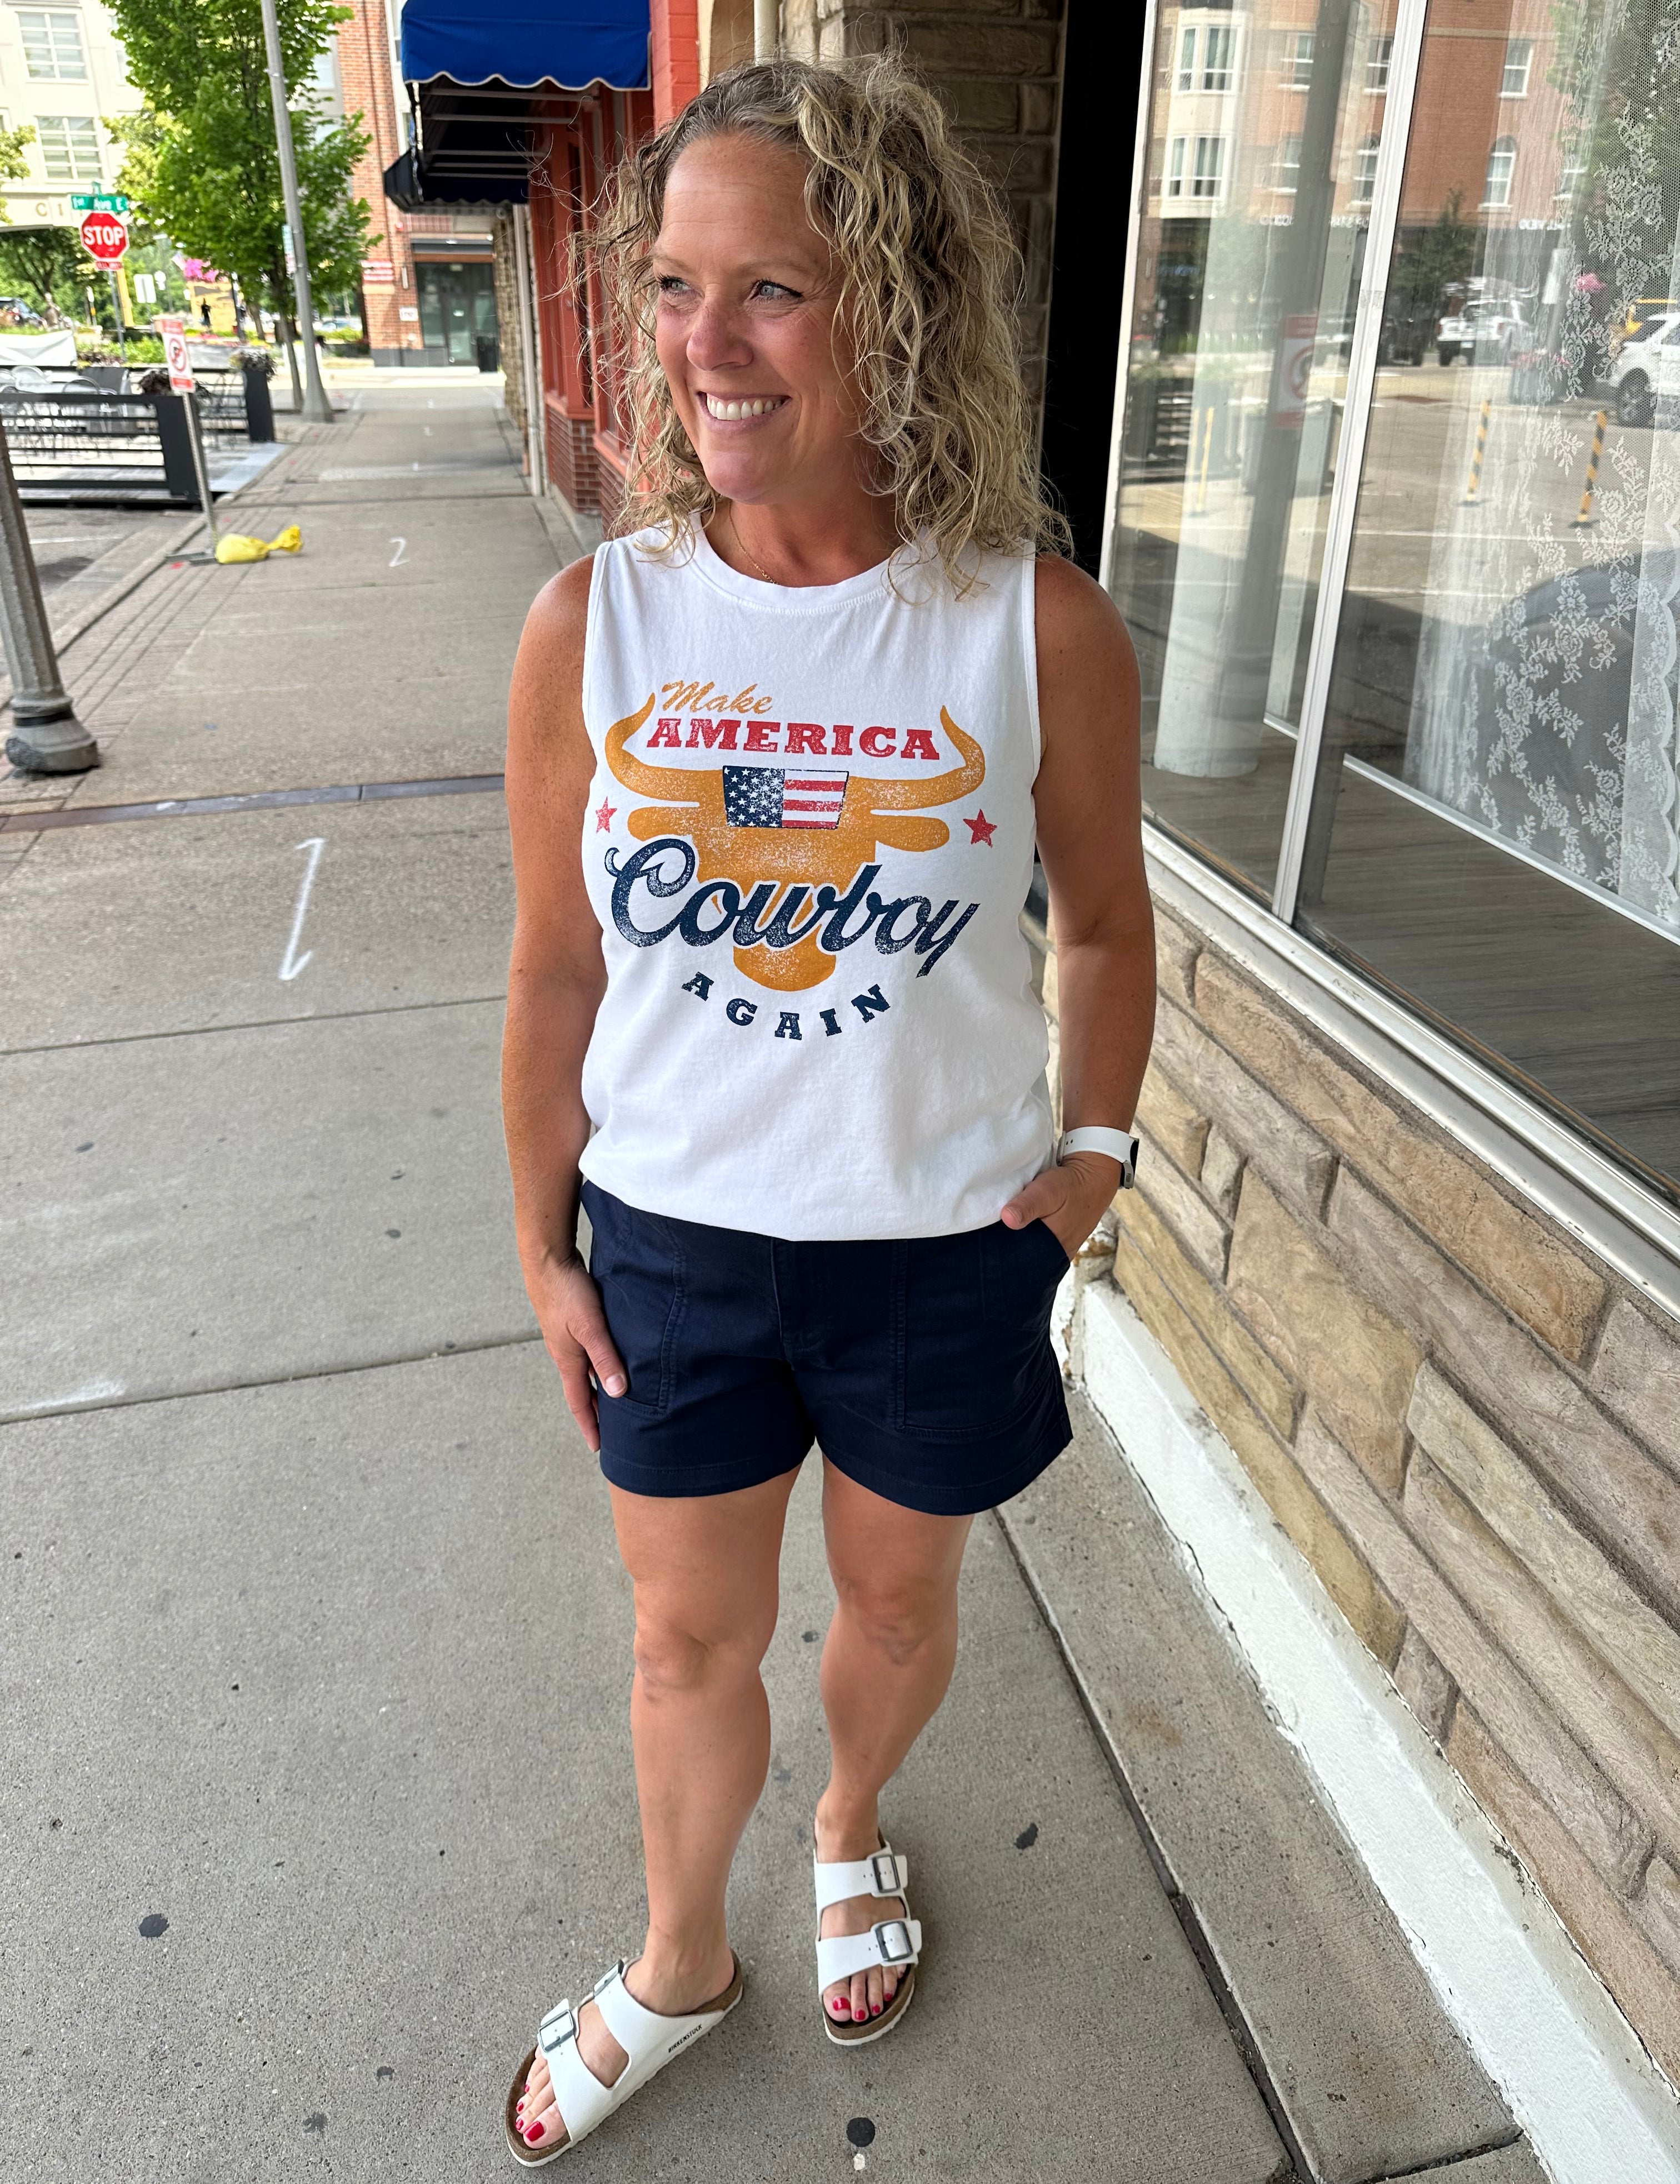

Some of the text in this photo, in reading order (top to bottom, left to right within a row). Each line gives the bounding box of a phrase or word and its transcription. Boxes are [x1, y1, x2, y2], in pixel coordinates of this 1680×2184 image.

[83, 226, 124, 246] STOP
[661, 679, 773, 715] Make
[646, 718, 941, 761] AMERICA
[604, 838, 981, 979] Cowboy
[681, 971, 891, 1041] AGAIN
